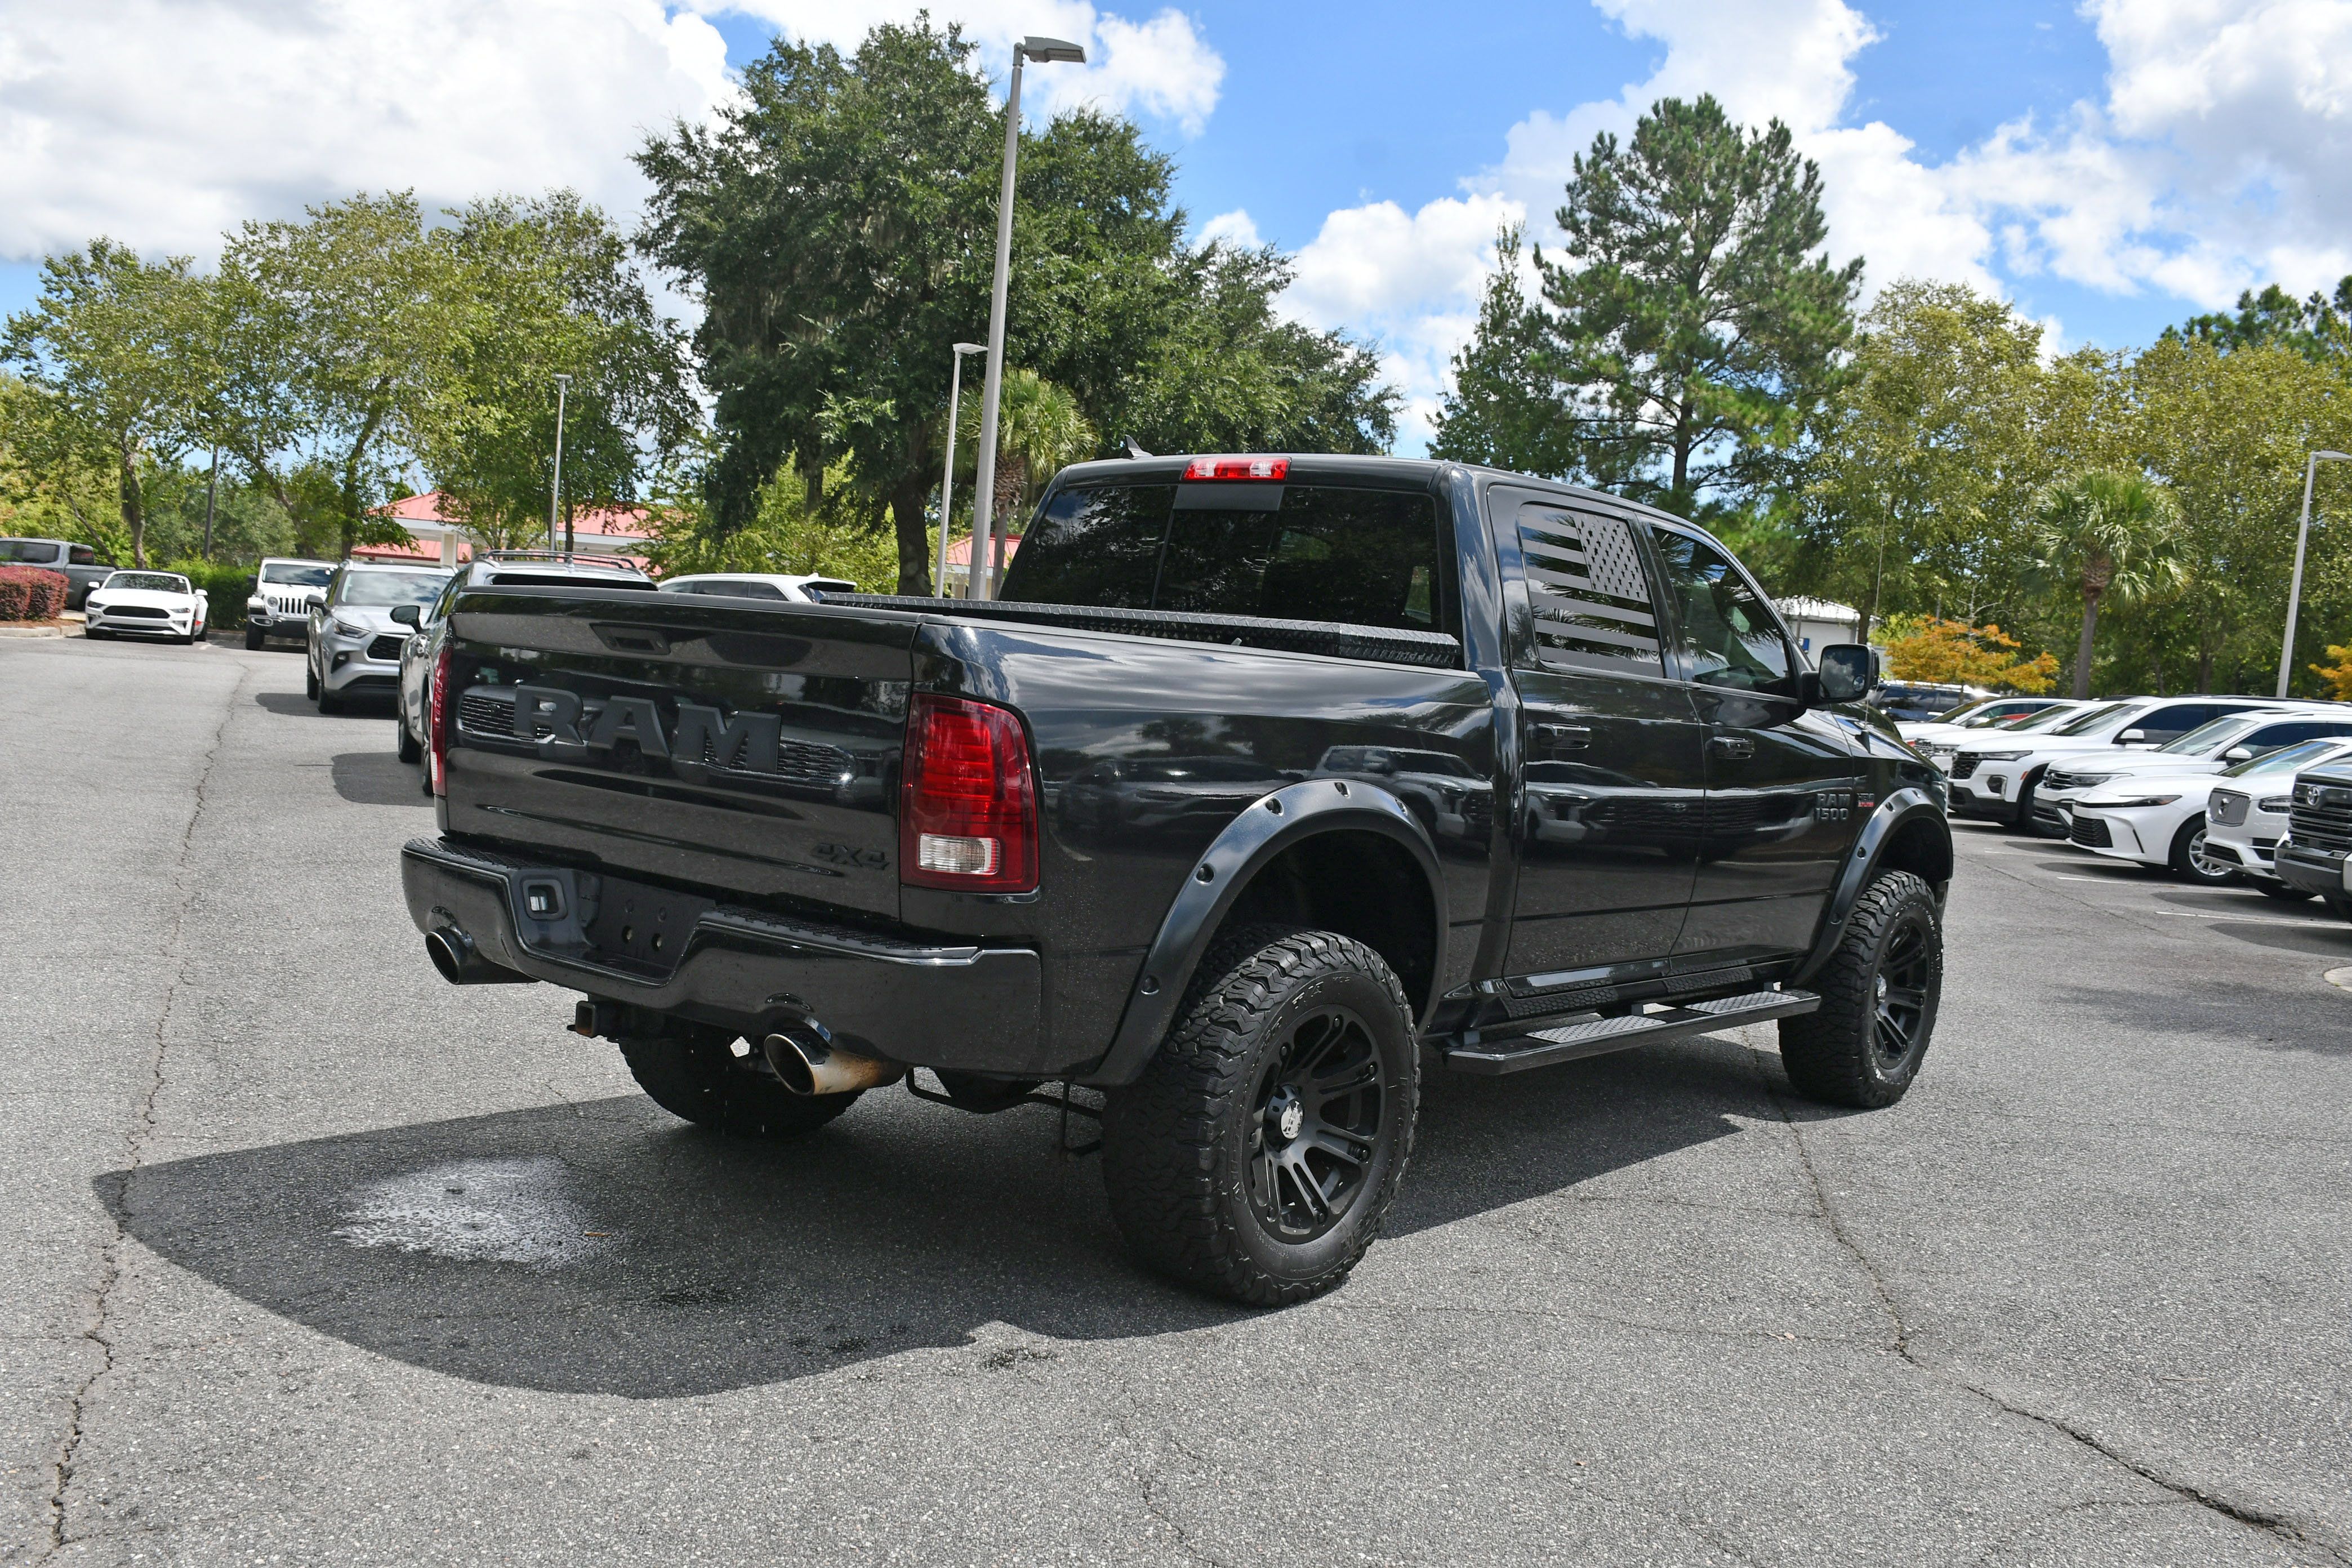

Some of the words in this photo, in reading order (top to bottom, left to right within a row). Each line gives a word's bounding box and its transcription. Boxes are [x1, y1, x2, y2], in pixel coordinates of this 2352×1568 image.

[514, 684, 782, 774] RAM
[1816, 793, 1851, 807] RAM
[1815, 808, 1848, 820] 1500
